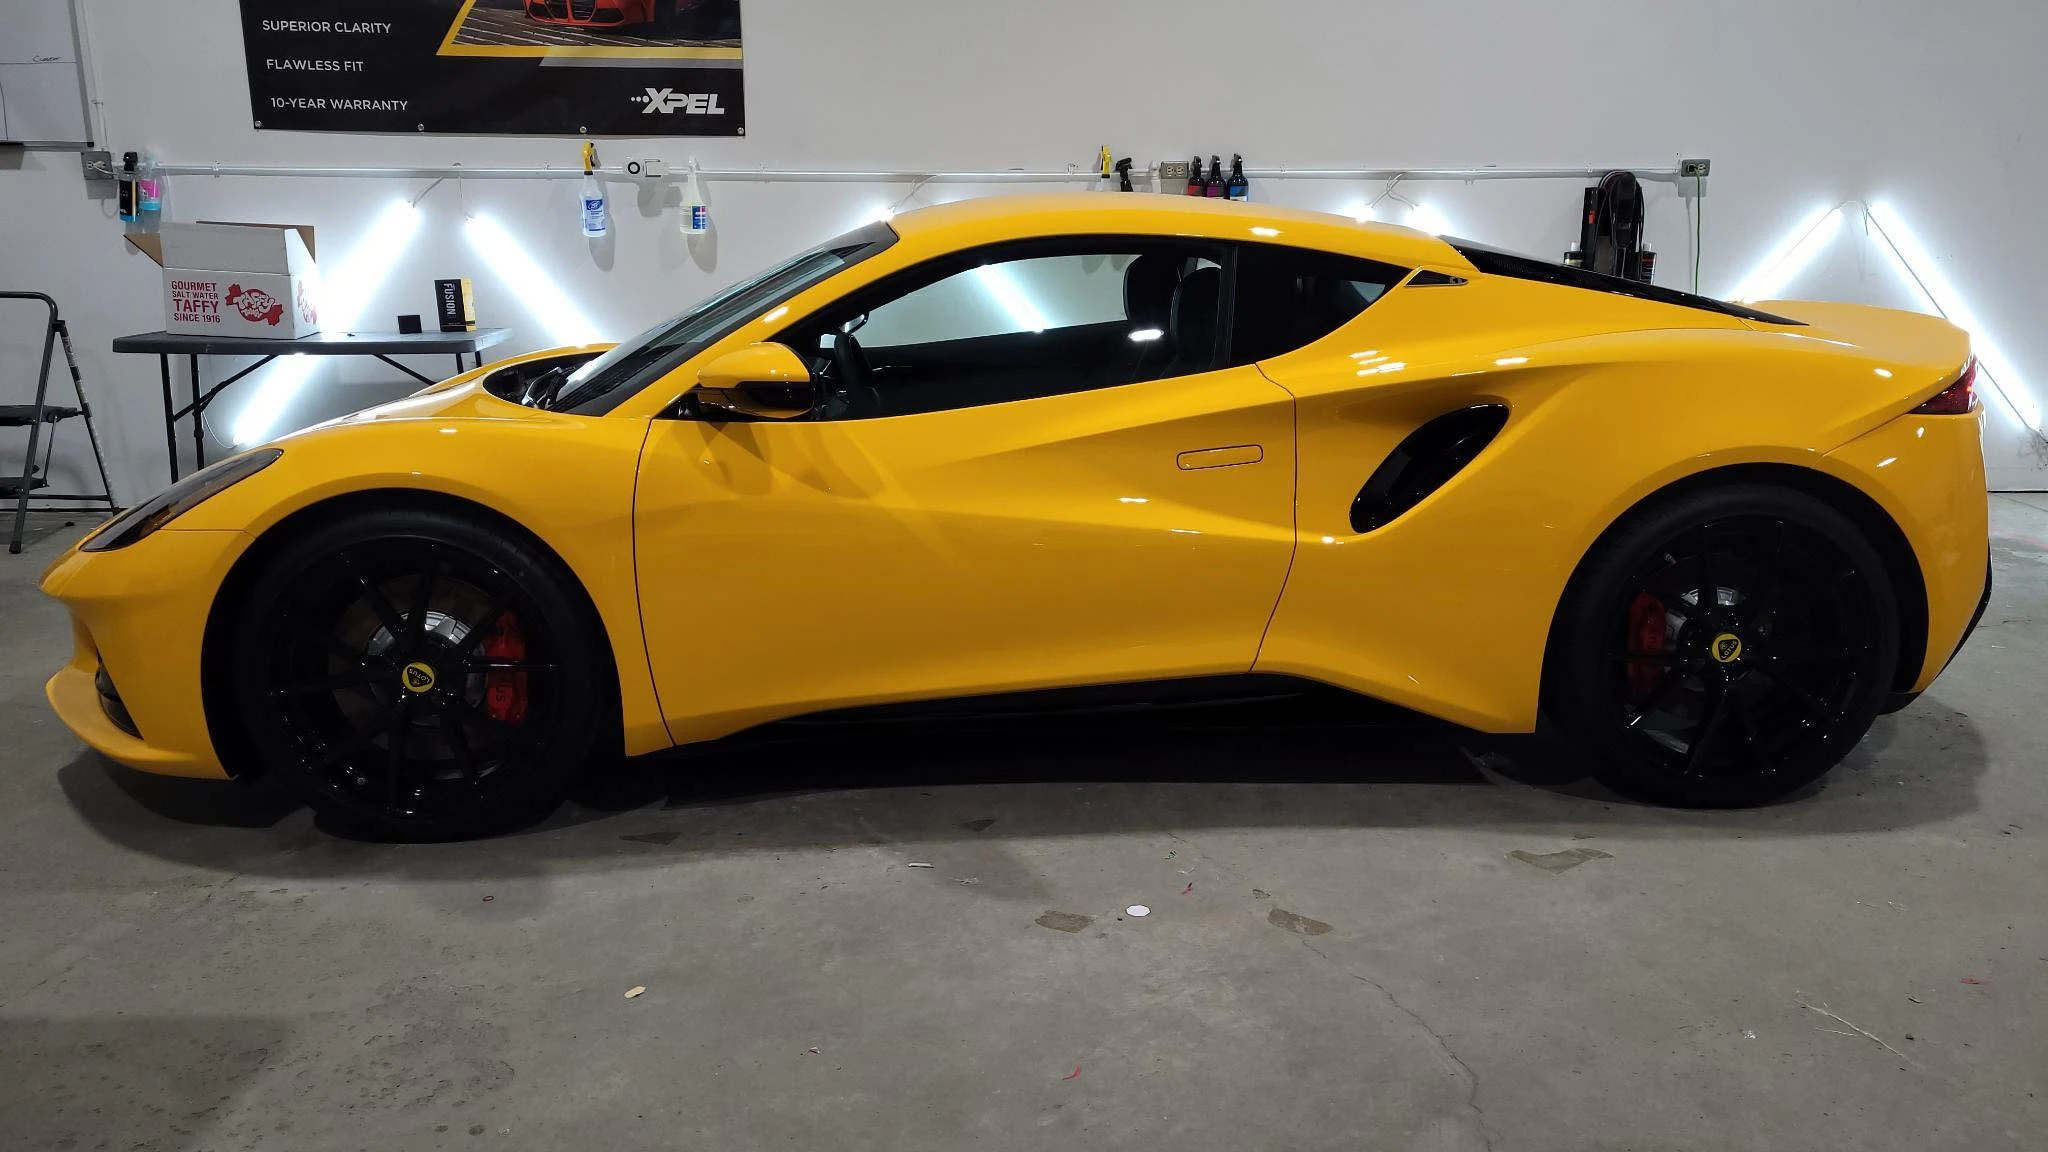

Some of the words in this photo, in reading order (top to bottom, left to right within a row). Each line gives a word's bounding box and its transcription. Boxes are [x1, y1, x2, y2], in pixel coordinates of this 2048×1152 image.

[262, 20, 331, 33] SUPERIOR
[334, 21, 391, 34] CLARITY
[266, 59, 340, 71] FLAWLESS
[344, 61, 364, 72] FIT
[270, 97, 326, 109] 10-YEAR
[330, 98, 408, 111] WARRANTY
[641, 87, 725, 115] XPEL
[171, 280, 217, 292] GOURMET
[172, 290, 190, 298] SALT
[192, 291, 219, 300] WATER
[443, 283, 456, 316] FUSION
[173, 299, 219, 314] TAFFY
[231, 291, 276, 314] TAFFY
[174, 312, 200, 323] SINCE
[202, 313, 221, 324] 1916
[408, 668, 431, 684] LOTUS
